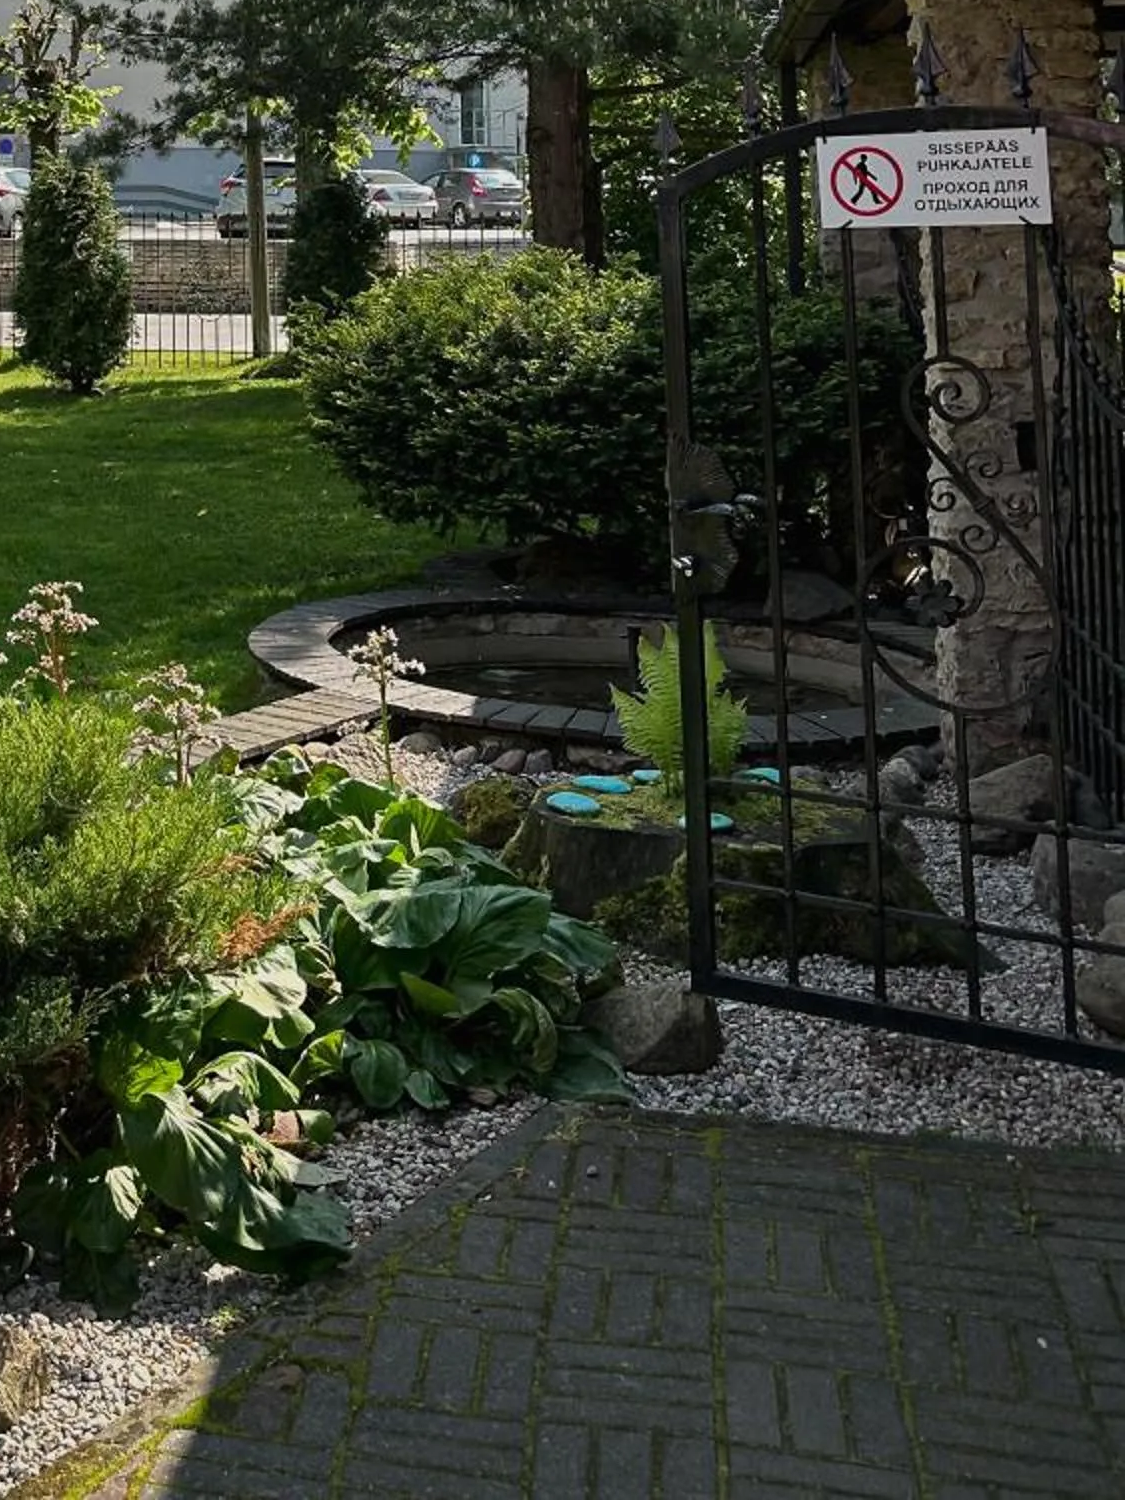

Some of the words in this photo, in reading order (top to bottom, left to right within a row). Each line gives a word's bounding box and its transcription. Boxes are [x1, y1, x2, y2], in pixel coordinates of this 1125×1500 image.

[928, 139, 1019, 155] SISSEPÄÄS
[917, 156, 1033, 172] PUHKAJATELE
[922, 182, 990, 195] ПРОХОД
[994, 179, 1028, 193] ДЛЯ
[914, 197, 1040, 211] ОТДЫХАЮЩИХ
